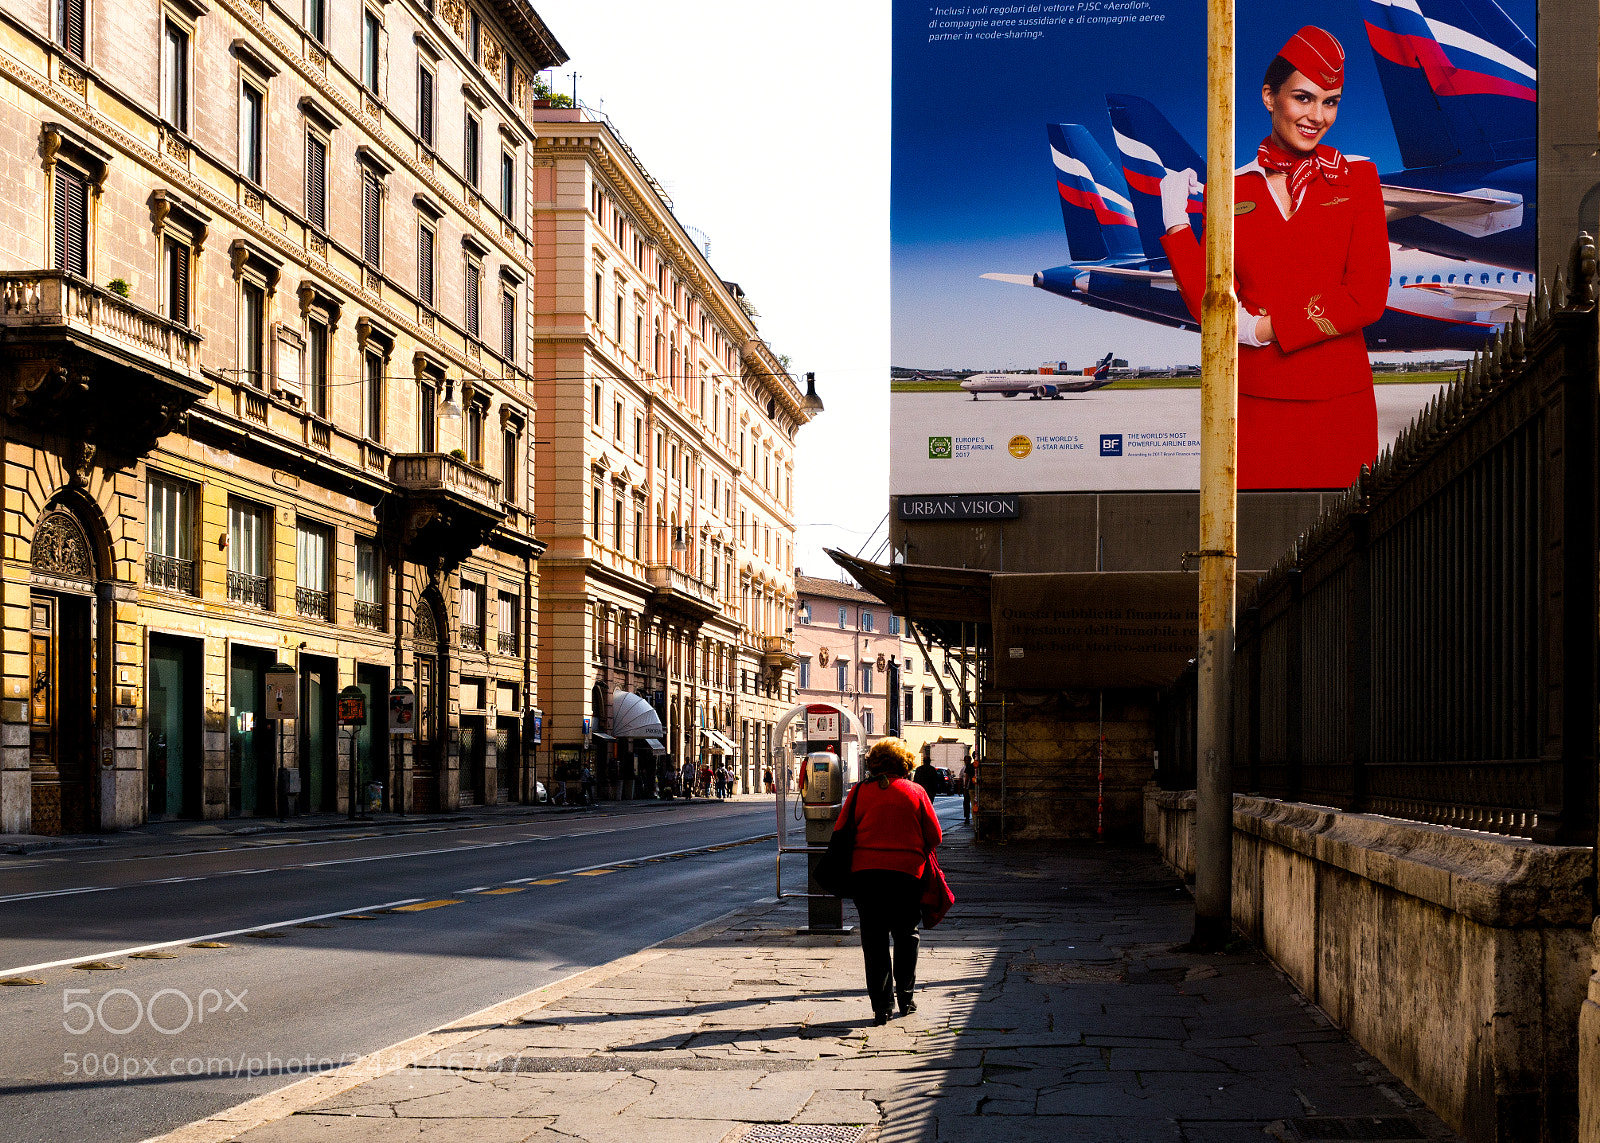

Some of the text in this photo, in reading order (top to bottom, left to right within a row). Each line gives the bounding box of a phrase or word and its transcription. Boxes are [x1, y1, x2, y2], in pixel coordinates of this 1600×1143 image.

[935, 6, 965, 15] Inclusi
[966, 5, 971, 15] i
[972, 5, 988, 15] voli
[989, 4, 1026, 16] regolari
[1027, 4, 1041, 13] del
[1043, 3, 1075, 12] vettore
[1077, 2, 1102, 11] PJSC
[928, 19, 938, 29] di
[940, 18, 988, 30] compagnie
[990, 19, 1016, 27] aeree
[1018, 15, 1067, 26] sussidiarie
[1076, 15, 1085, 24] di
[1087, 13, 1136, 26] compagnie
[1139, 14, 1166, 22] aeree
[928, 32, 962, 43] partner
[964, 31, 973, 40] in
[1103, 439, 1120, 449] BF
[1127, 440, 1161, 448] POWERFUL
[903, 500, 1014, 515] URBAN VISION
[1002, 607, 1198, 621] Questa pubblicità finanzia in
[1023, 625, 1081, 636] restauro
[1182, 627, 1198, 637] re
[1086, 642, 1194, 654] storico-artistico
